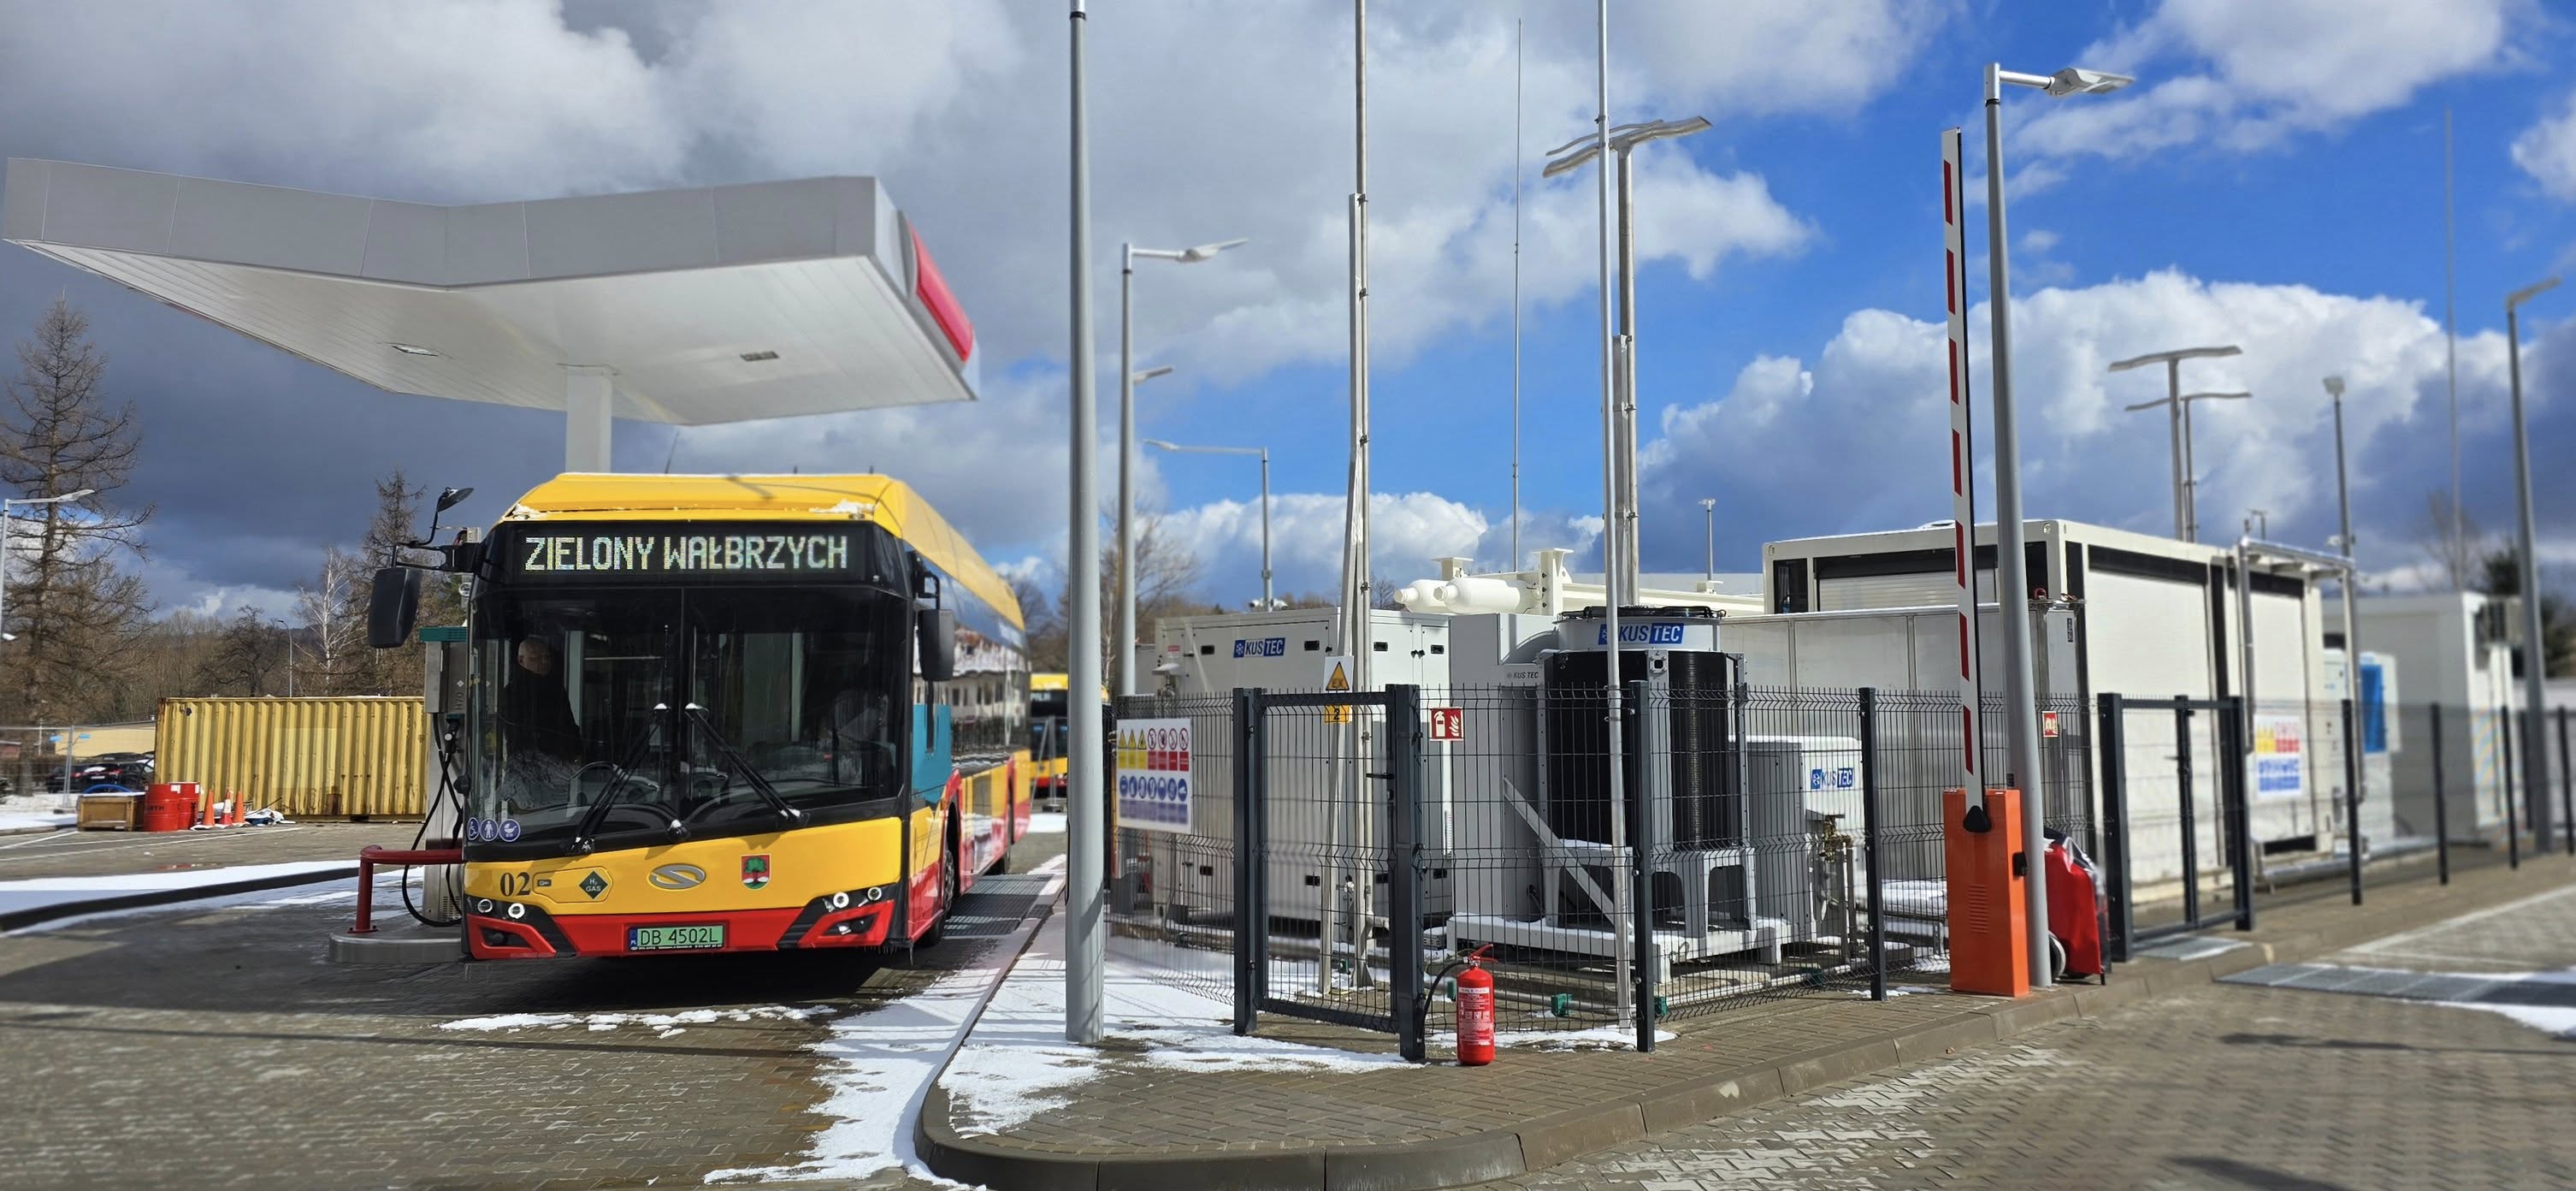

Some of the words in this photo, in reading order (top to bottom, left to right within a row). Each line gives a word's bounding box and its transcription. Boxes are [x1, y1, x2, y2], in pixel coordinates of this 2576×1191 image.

[525, 536, 654, 571] ZIELONY
[664, 536, 848, 570] WAŁBRZYCH
[1333, 708, 1340, 720] 2
[500, 872, 531, 897] 02
[641, 930, 661, 945] DB
[668, 927, 719, 945] 4502L
